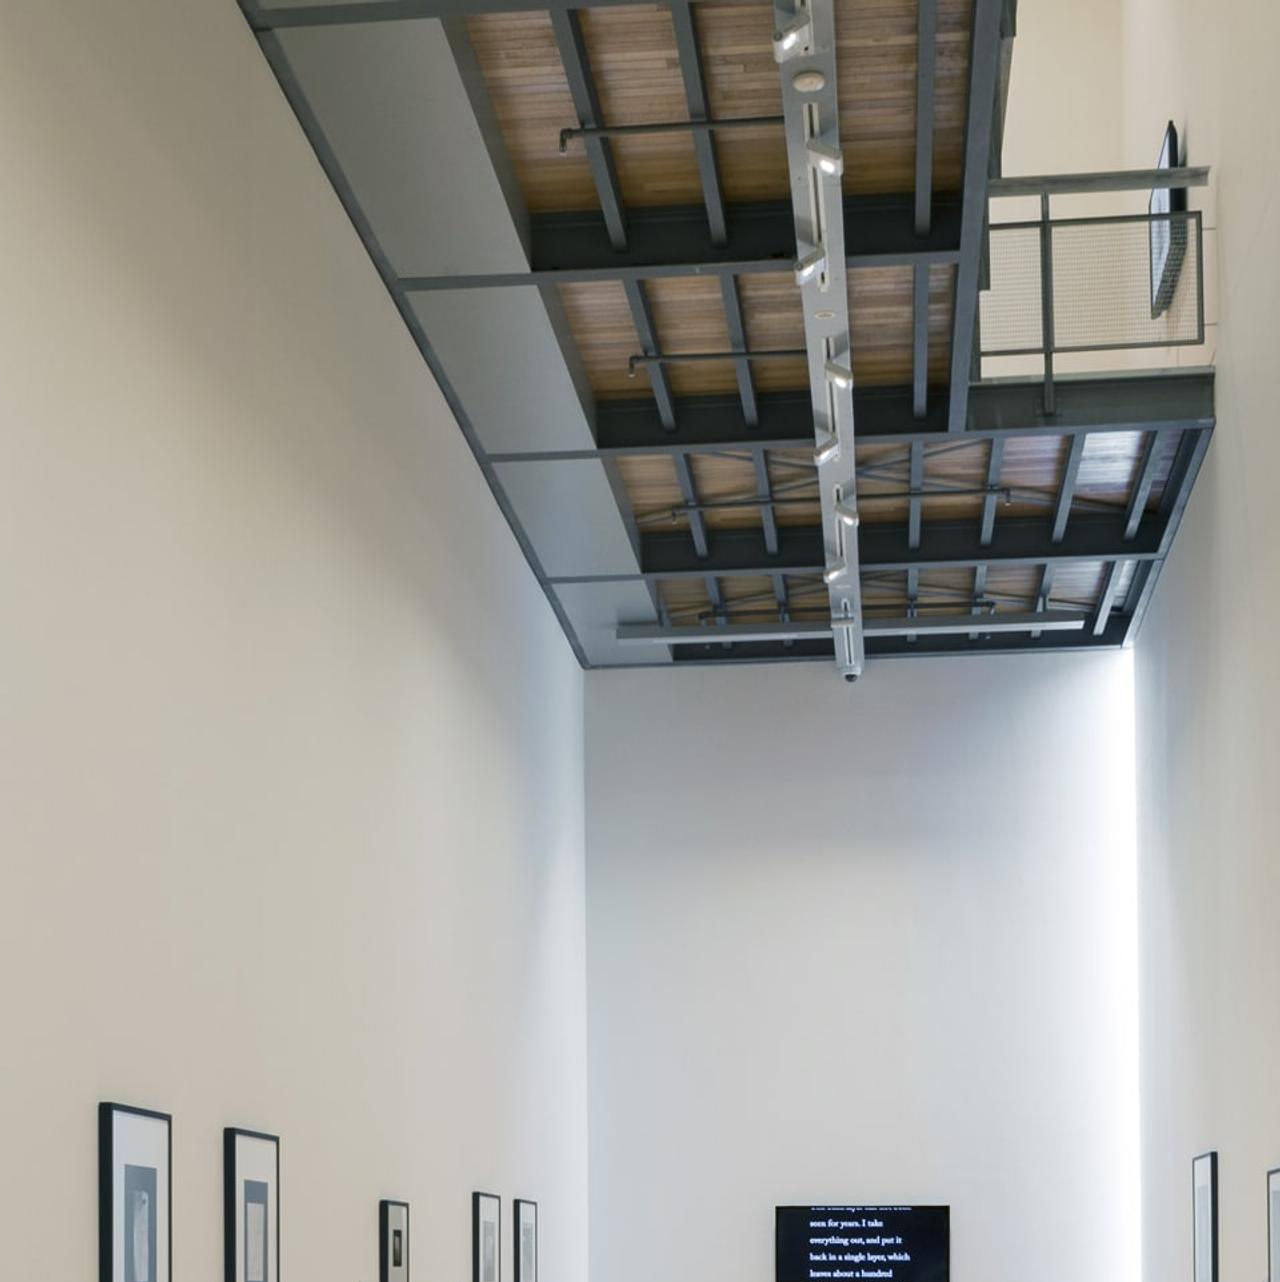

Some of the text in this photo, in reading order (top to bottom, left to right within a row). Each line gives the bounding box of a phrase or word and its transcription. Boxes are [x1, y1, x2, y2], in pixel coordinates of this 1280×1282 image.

[828, 1219, 839, 1228] for
[840, 1220, 860, 1230] years.
[862, 1218, 866, 1228] I
[867, 1219, 883, 1228] take
[809, 1235, 902, 1246] everything out, and put it
[809, 1252, 827, 1261] back
[828, 1252, 837, 1261] in
[844, 1252, 866, 1263] single
[866, 1252, 887, 1263] layer,
[887, 1252, 911, 1261] which
[832, 1269, 854, 1278] about
[861, 1268, 893, 1278] hundred
